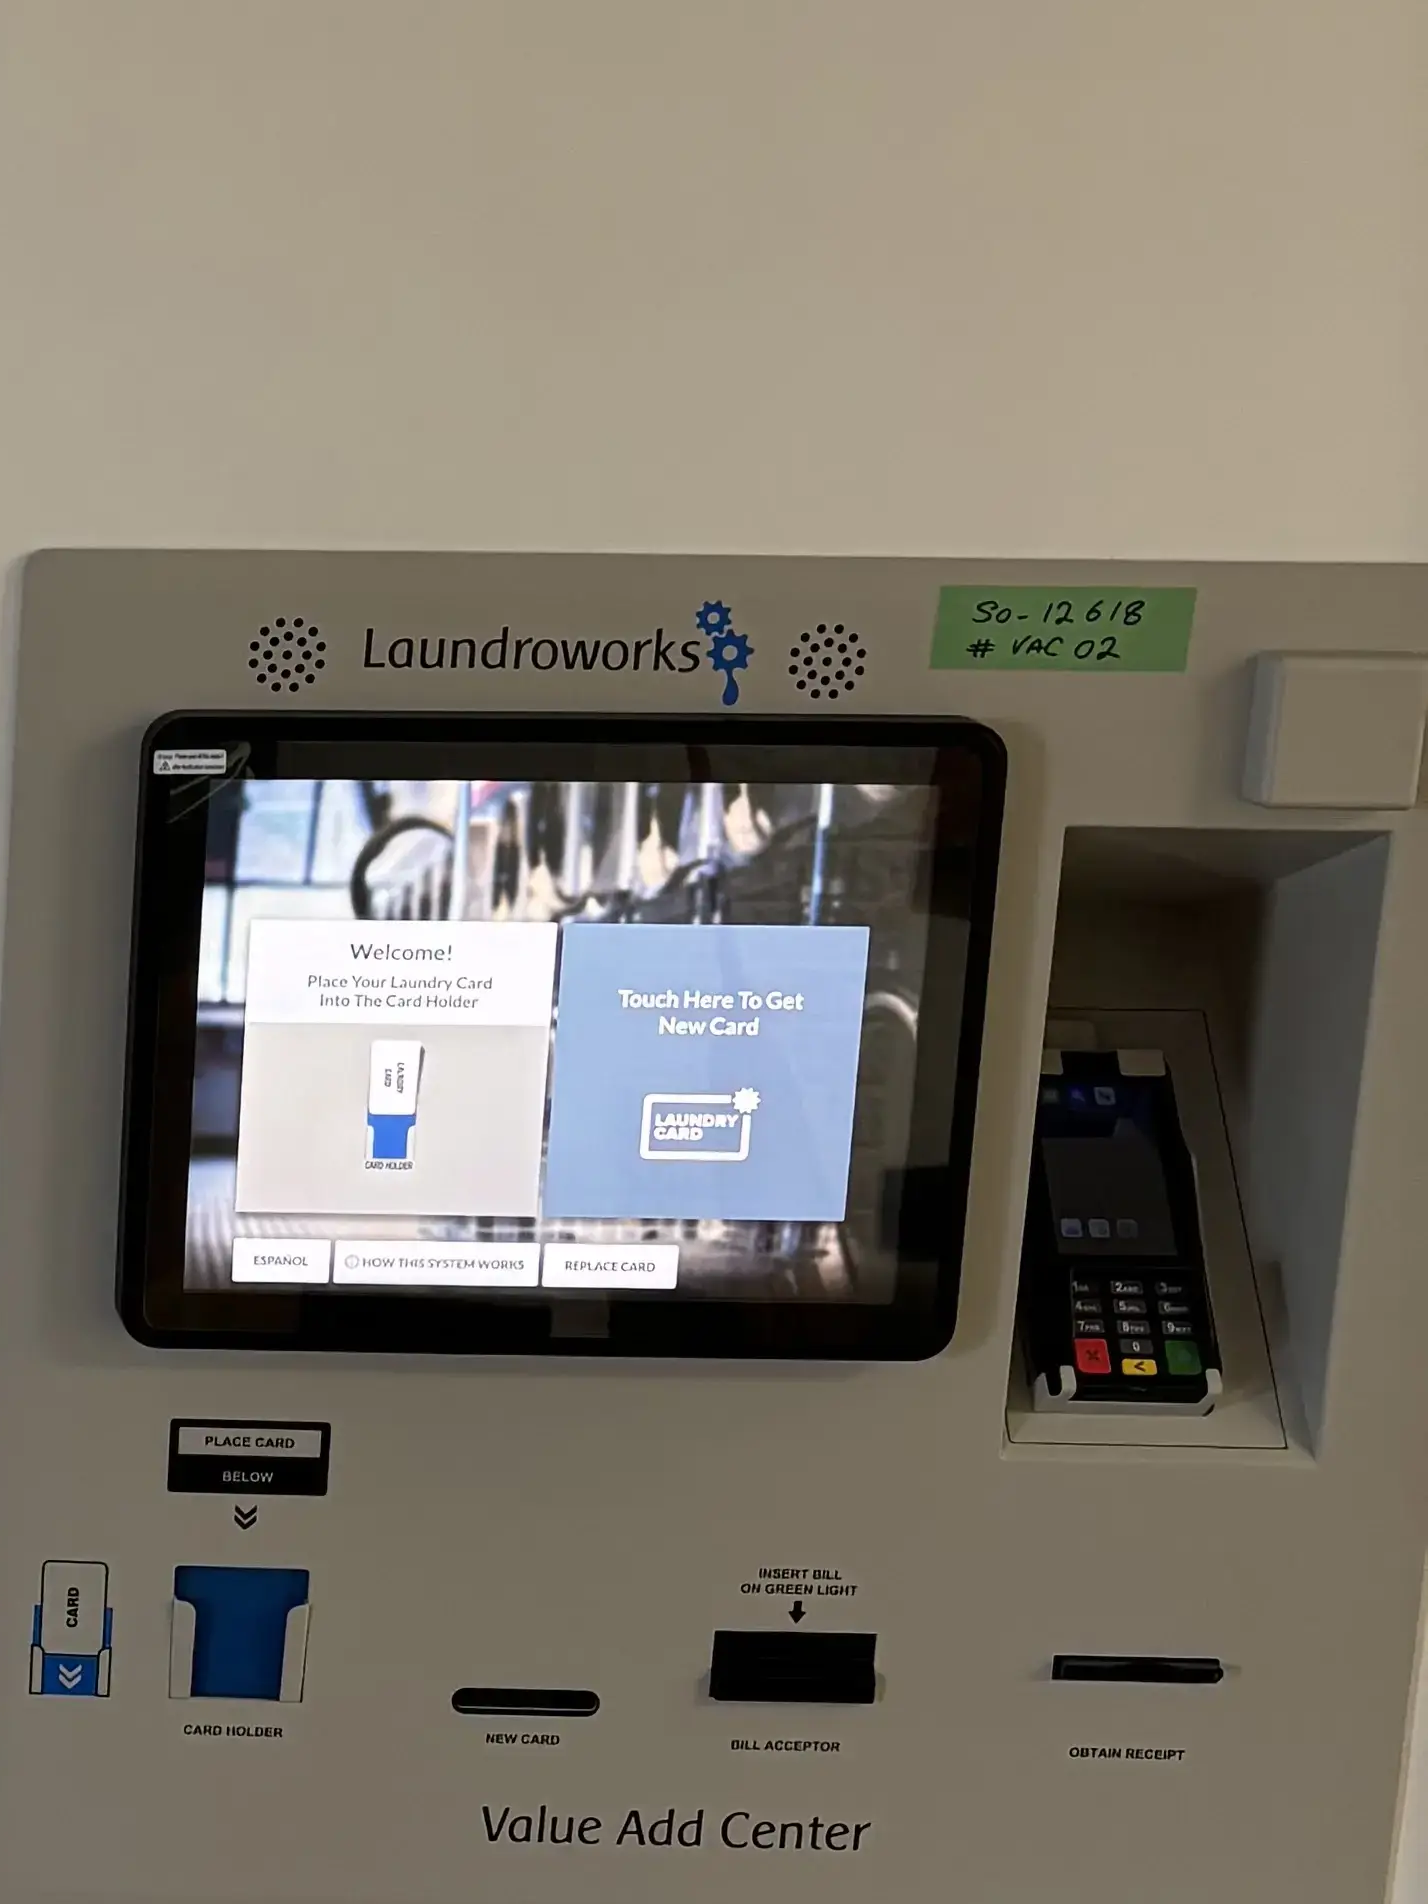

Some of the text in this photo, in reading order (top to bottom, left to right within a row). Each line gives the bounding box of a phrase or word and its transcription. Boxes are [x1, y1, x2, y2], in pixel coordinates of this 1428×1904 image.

[364, 627, 701, 673] Laundroworks
[350, 943, 452, 961] Welcome!
[307, 975, 493, 991] Place Your Laundry Card
[319, 994, 479, 1008] Into The Card Holder
[618, 989, 804, 1010] Touch Here To Get
[658, 1016, 760, 1036] New Card
[655, 1113, 738, 1127] LAUNDRY
[654, 1127, 703, 1140] CARD
[253, 1254, 309, 1267] ESPAÑOL
[362, 1258, 525, 1271] HOW THIS SYSTEM WORKS
[565, 1261, 656, 1273] REPLACE CARD
[205, 1436, 295, 1449] PLACE CARD
[222, 1471, 274, 1483] BELOW
[759, 1568, 842, 1580] INSERT BILL
[740, 1583, 858, 1596] ON GREEN LIGHT
[66, 1587, 80, 1628] CARD
[183, 1724, 283, 1738] CARD HOLDER
[485, 1733, 560, 1746] NEW CARD
[731, 1739, 840, 1752] BILL ACCEPTOR
[1069, 1747, 1185, 1760] OBTAIN RECEIPT
[482, 1805, 871, 1852] Value Add Center
